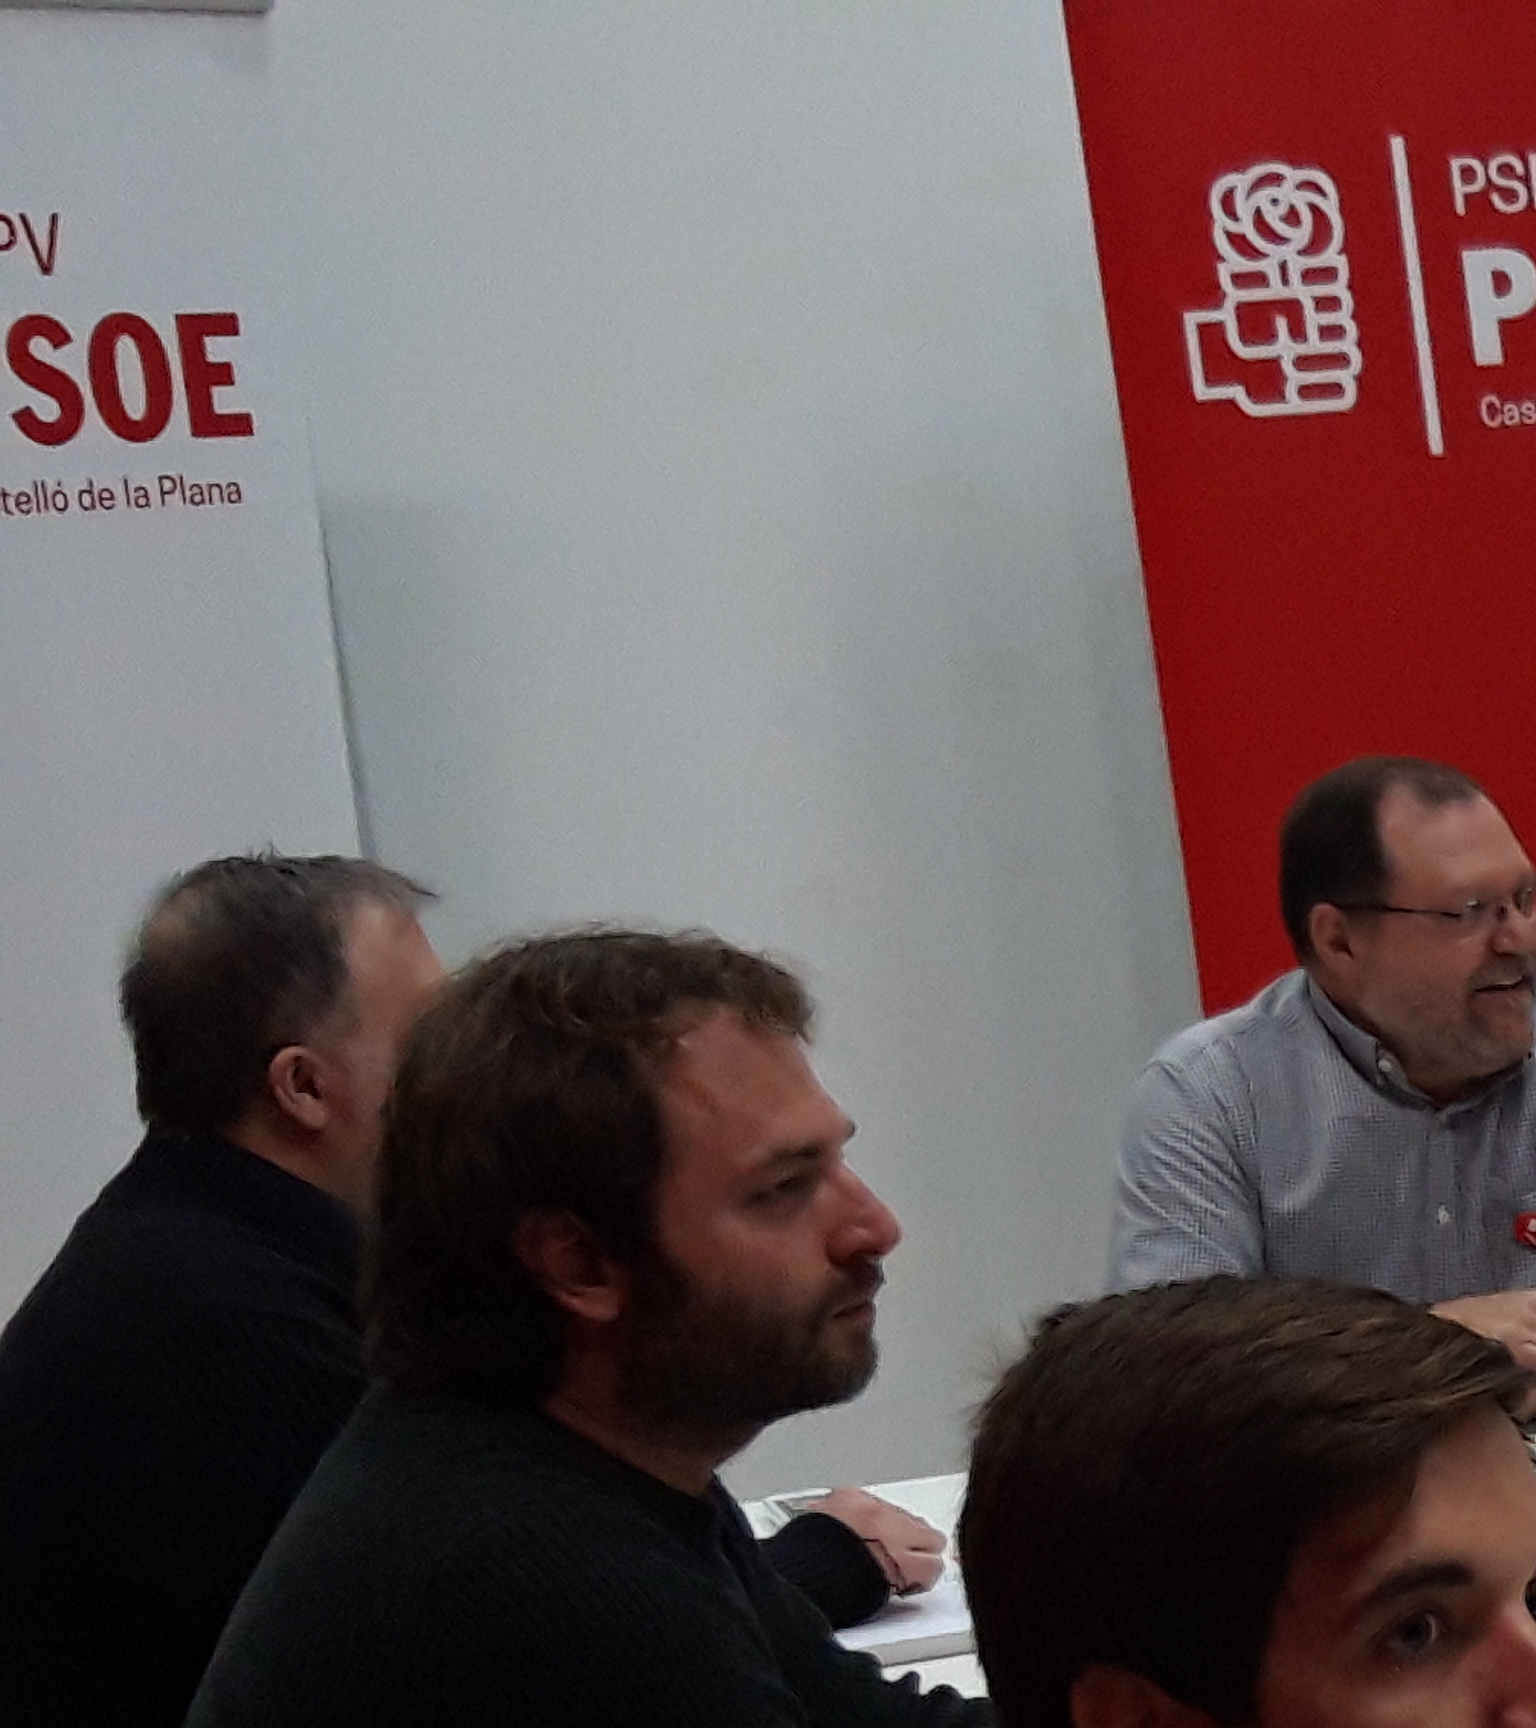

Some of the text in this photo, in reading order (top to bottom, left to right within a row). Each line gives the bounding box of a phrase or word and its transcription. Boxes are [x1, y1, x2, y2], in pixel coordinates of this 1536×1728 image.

[6, 312, 254, 447] SOE
[78, 476, 116, 510] de
[123, 475, 151, 509] la
[157, 473, 243, 507] Plana
